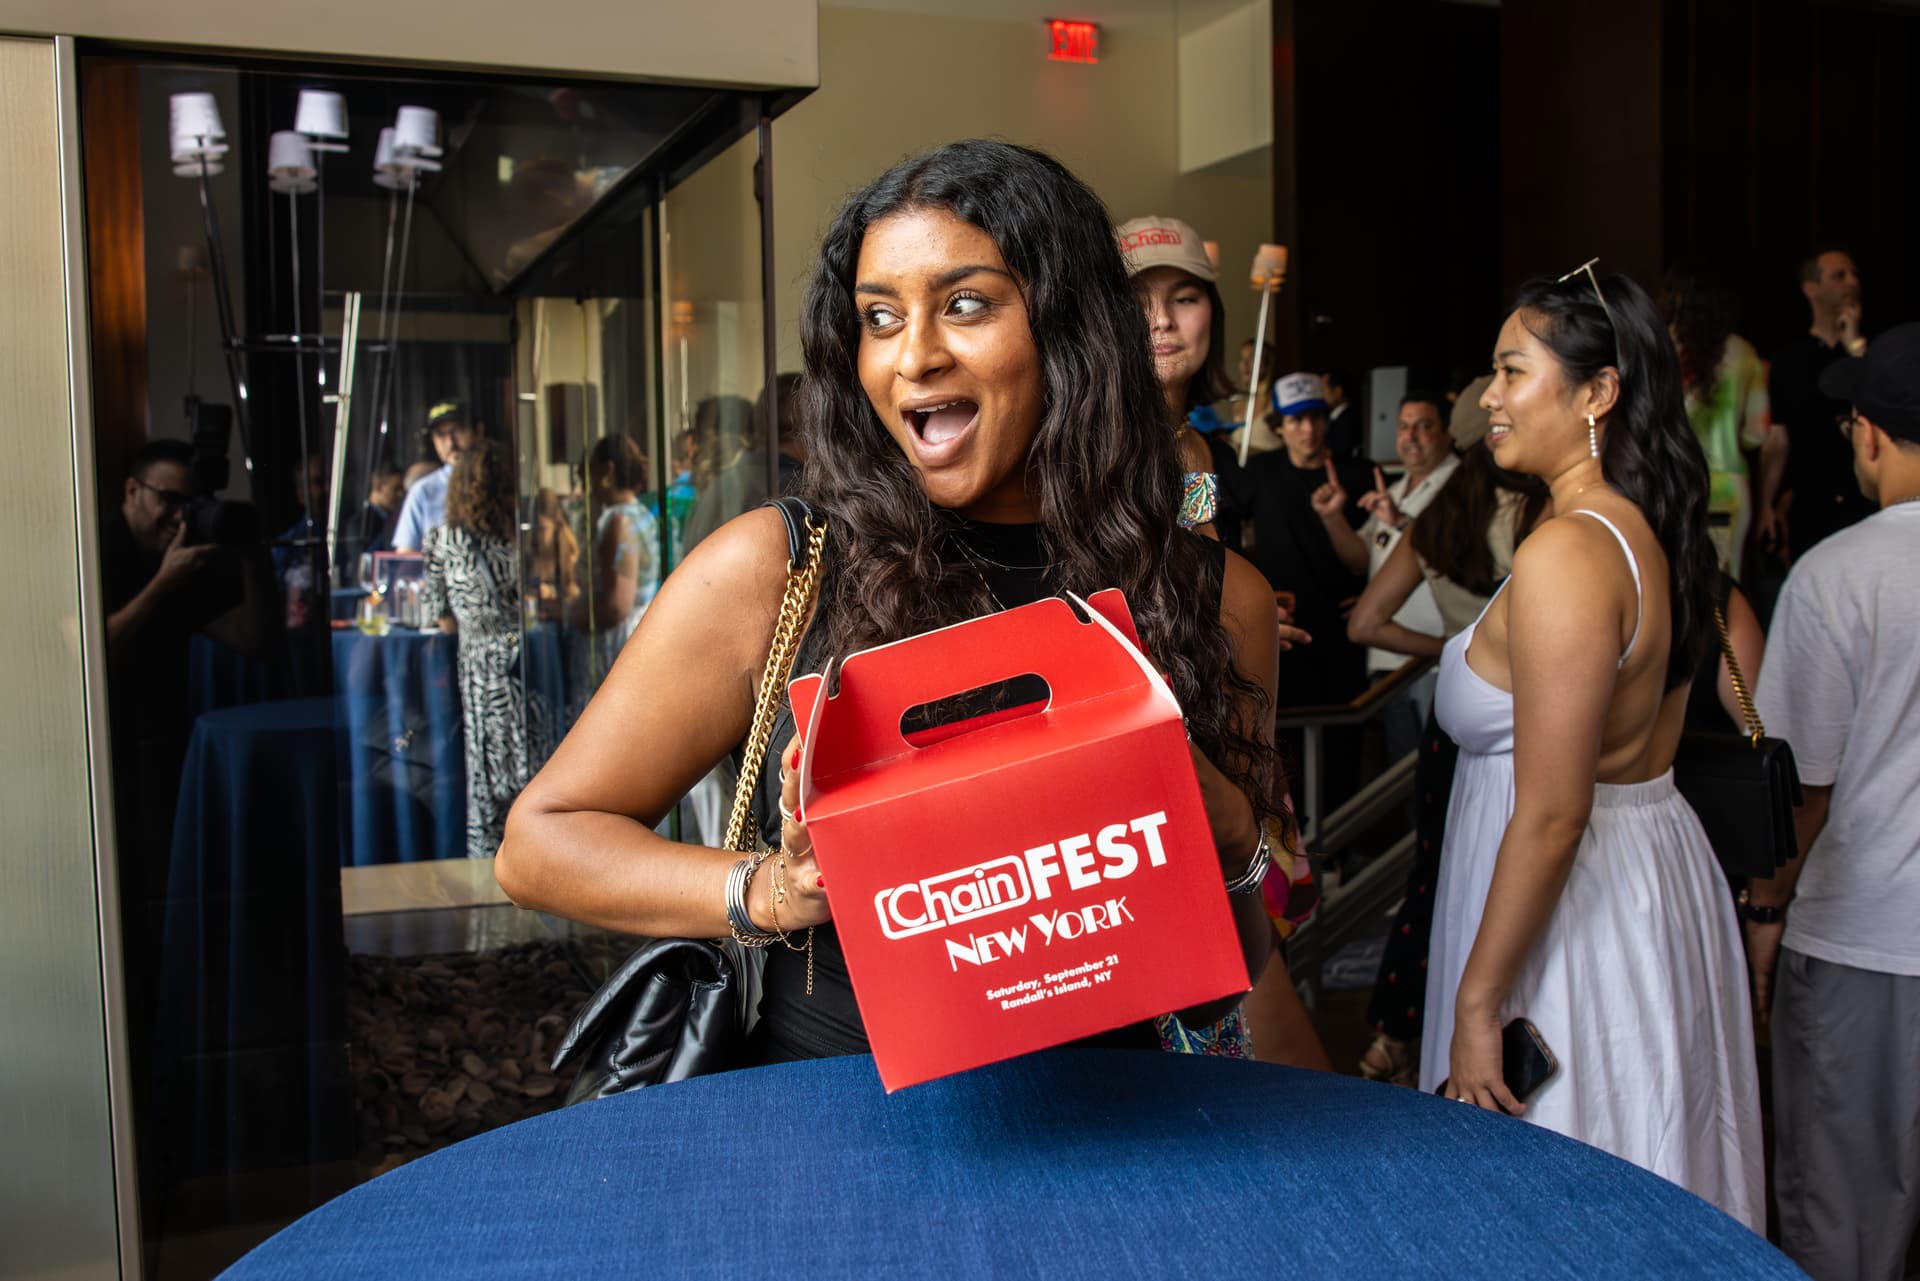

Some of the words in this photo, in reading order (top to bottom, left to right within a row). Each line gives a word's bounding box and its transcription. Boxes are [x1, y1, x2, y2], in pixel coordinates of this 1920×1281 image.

[945, 924, 1027, 972] NEW
[1029, 896, 1134, 946] YORK
[986, 980, 1041, 1000] Saturday,
[1043, 961, 1104, 983] September
[1105, 954, 1119, 967] 21
[1001, 989, 1053, 1011] Randall's
[1053, 976, 1092, 995] Island,
[1094, 970, 1112, 984] NY
